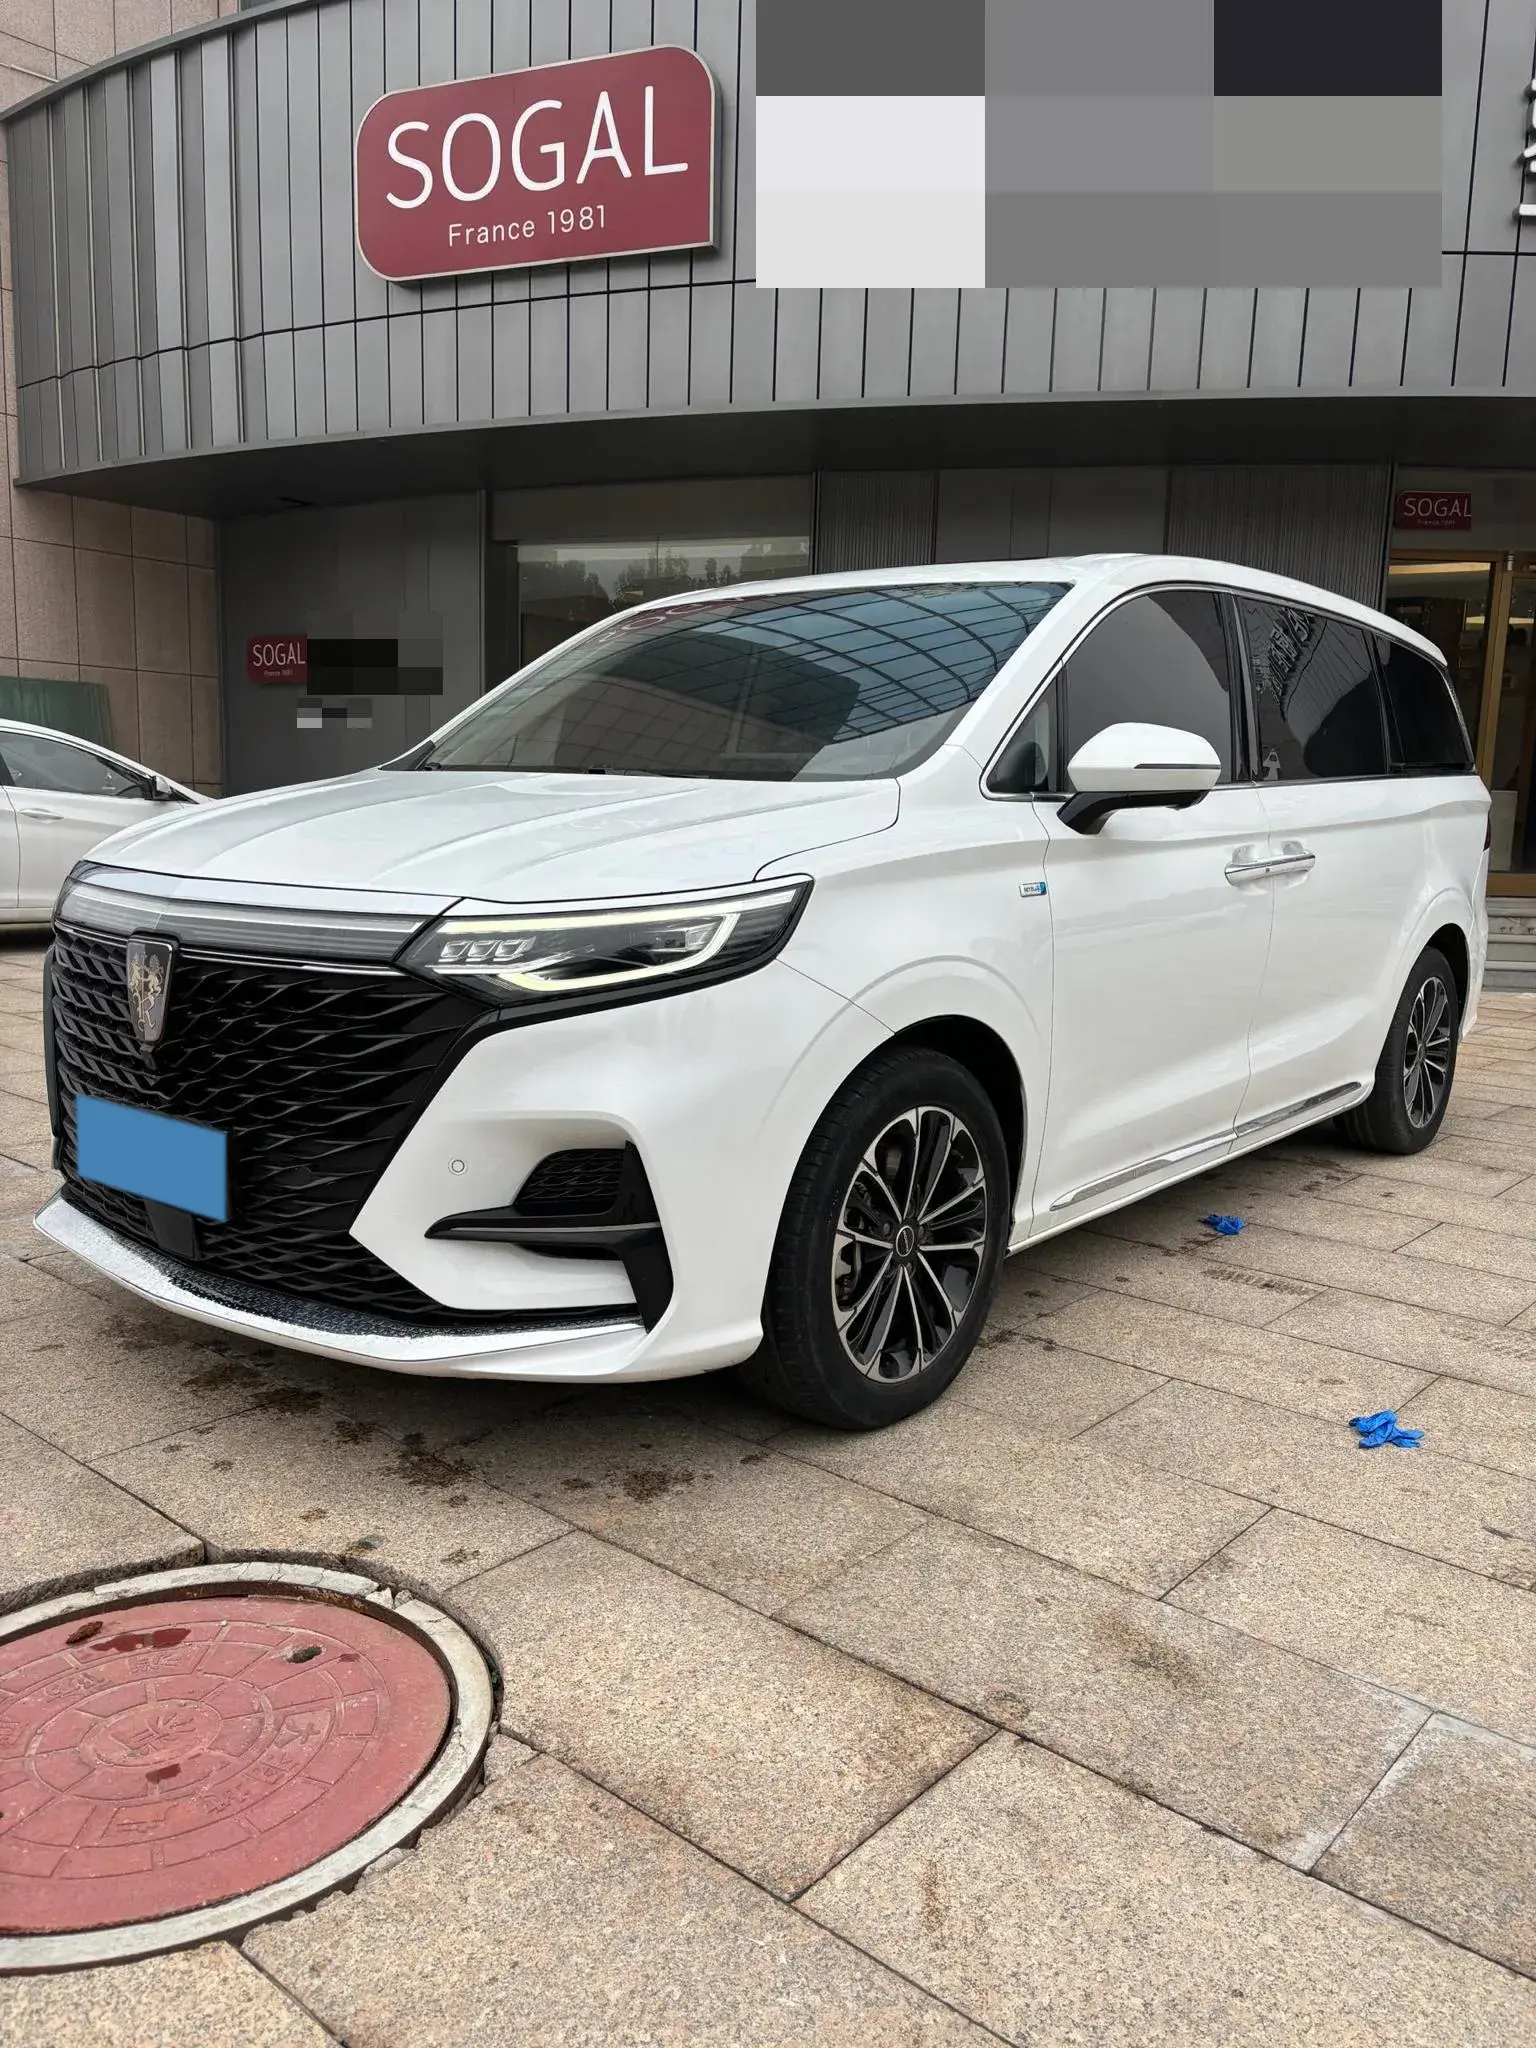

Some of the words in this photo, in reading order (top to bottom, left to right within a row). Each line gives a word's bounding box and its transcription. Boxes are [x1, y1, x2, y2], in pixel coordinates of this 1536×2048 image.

[385, 85, 689, 209] SOGAL
[448, 222, 535, 247] France
[547, 204, 606, 235] 1981
[1403, 498, 1472, 517] SOGAL
[252, 642, 306, 667] SOGAL
